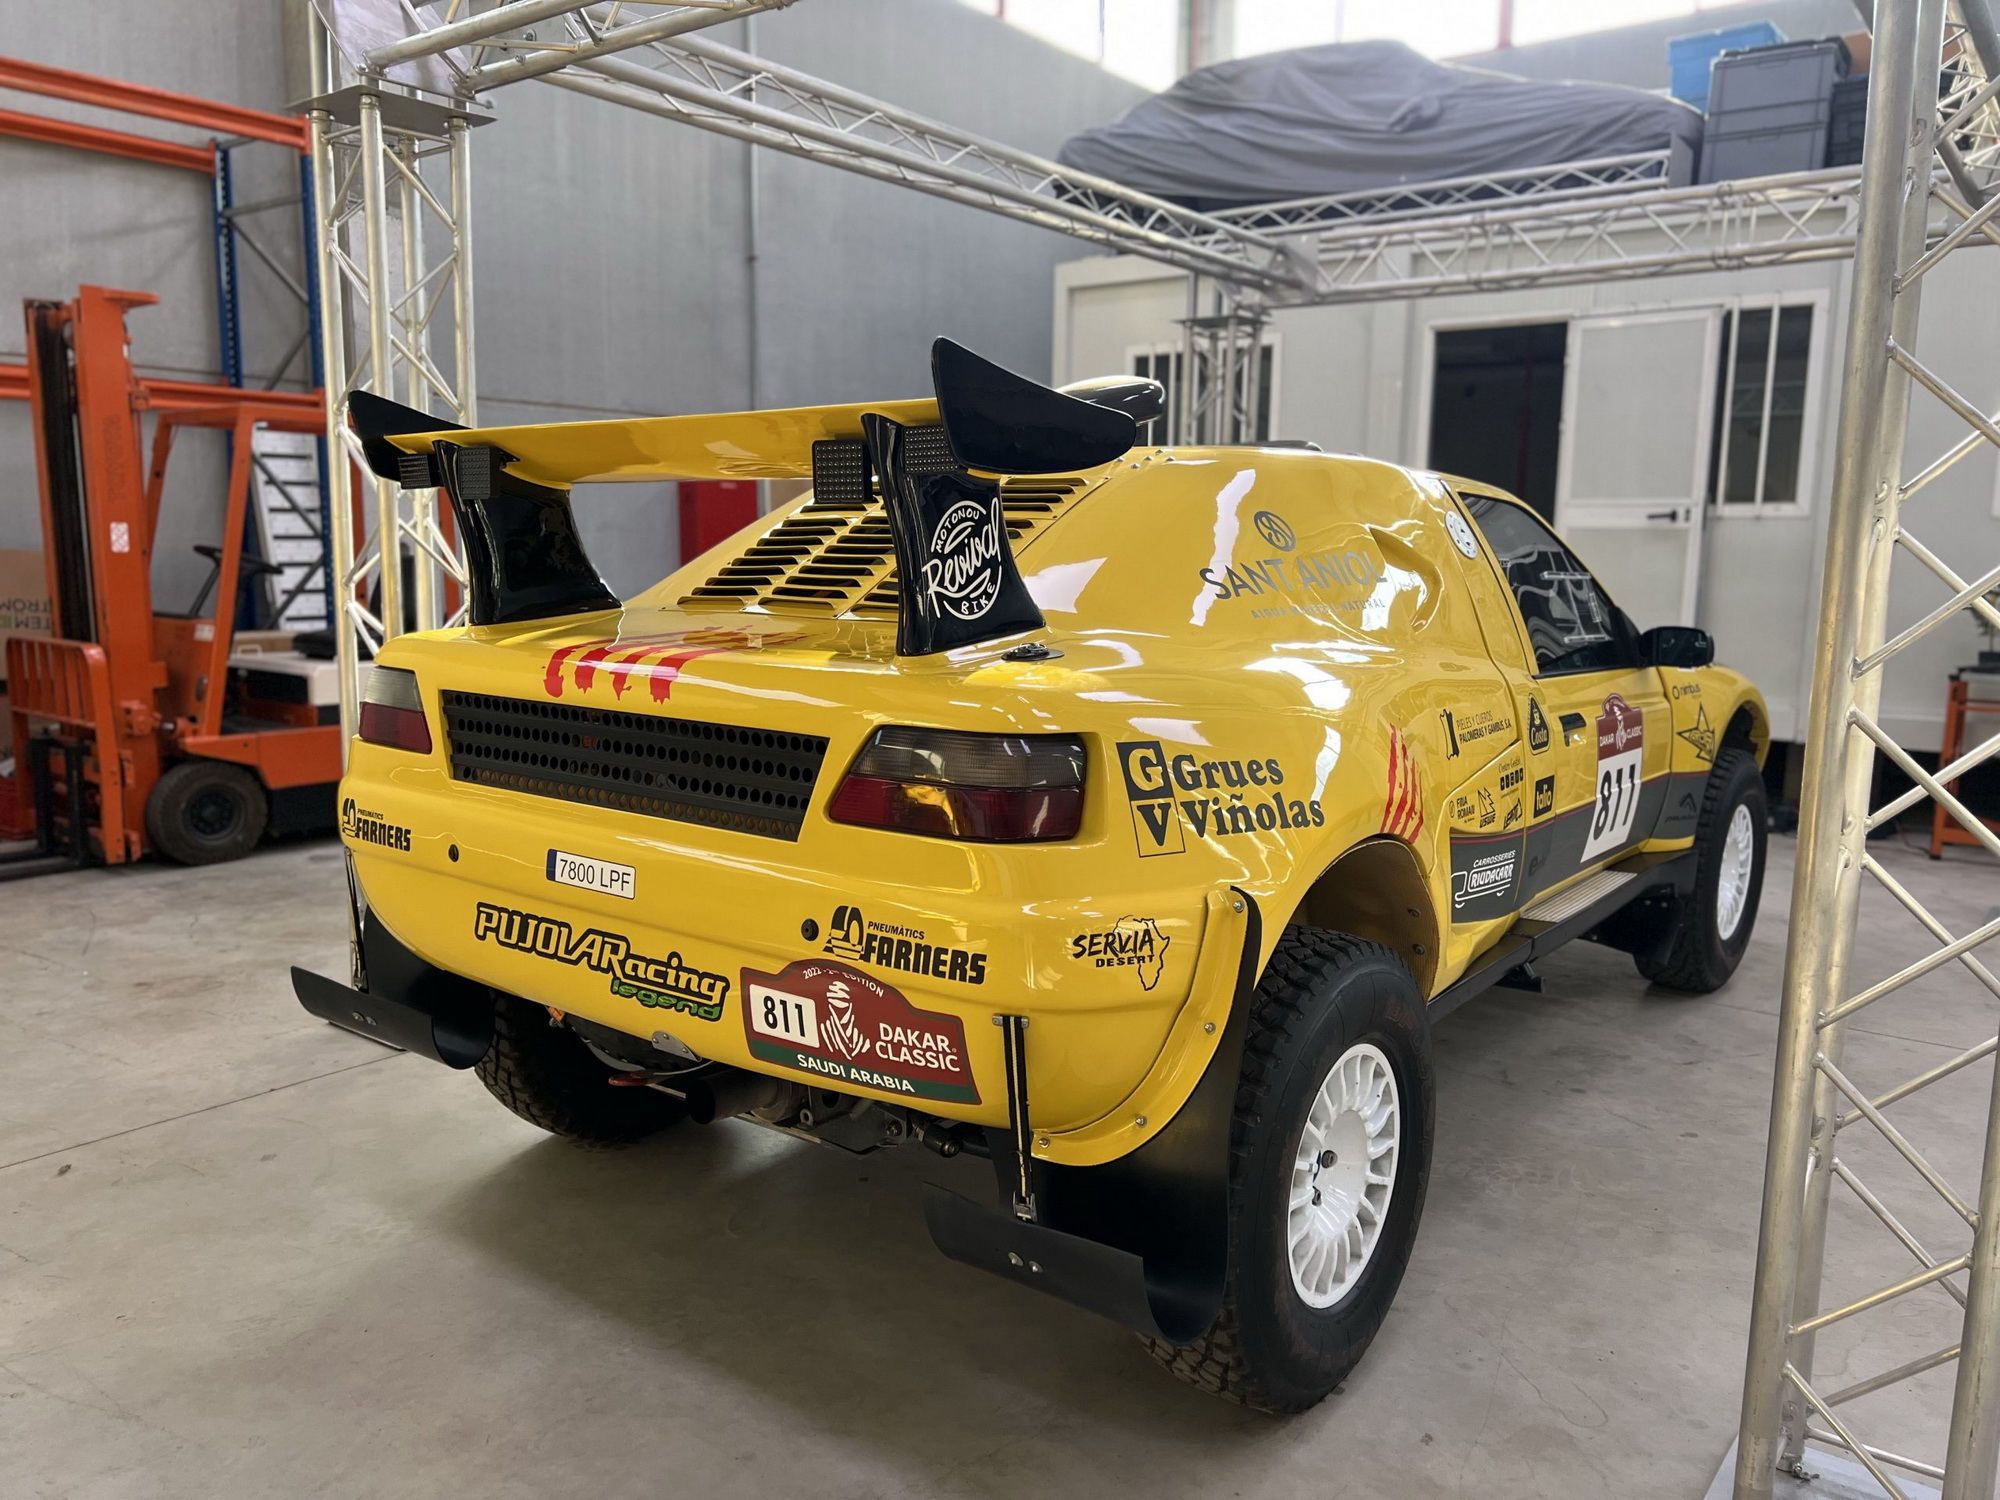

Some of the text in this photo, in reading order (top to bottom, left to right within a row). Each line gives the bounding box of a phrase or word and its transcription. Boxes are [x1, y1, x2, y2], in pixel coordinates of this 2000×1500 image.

[936, 508, 980, 553] MOTONOU
[921, 497, 1001, 618] Revival
[1199, 551, 1388, 600] SANT ANIOL
[961, 582, 995, 614] BIKE
[1340, 598, 1386, 612] NATURAL
[1456, 717, 1472, 730] PIELES
[1475, 710, 1493, 725] CUEROS
[1459, 727, 1485, 744] PALOMERAS
[1531, 727, 1548, 745] Costa
[1599, 725, 1642, 747] DAKAR CLASSIC
[1128, 747, 1164, 791] G
[1172, 753, 1284, 791] Grues
[1181, 792, 1325, 838] Viñolas
[1593, 763, 1636, 841] 811
[355, 816, 411, 852] FARNERS
[1137, 802, 1171, 847] V
[559, 858, 631, 892] 7800 LPF
[1473, 850, 1516, 868] CARROSSERIES
[867, 920, 925, 940] PNEUMÀTICS
[1072, 928, 1154, 959] SERVIA
[803, 967, 822, 980] 2022
[862, 933, 988, 985] FARNERS
[1095, 955, 1155, 968] DESERT
[611, 979, 722, 1021] legend
[763, 995, 806, 1037] 811
[879, 1022, 952, 1053] DAKAR
[797, 1054, 915, 1093] SAUDI ARABIA
[875, 1041, 961, 1072] CLASSIC
